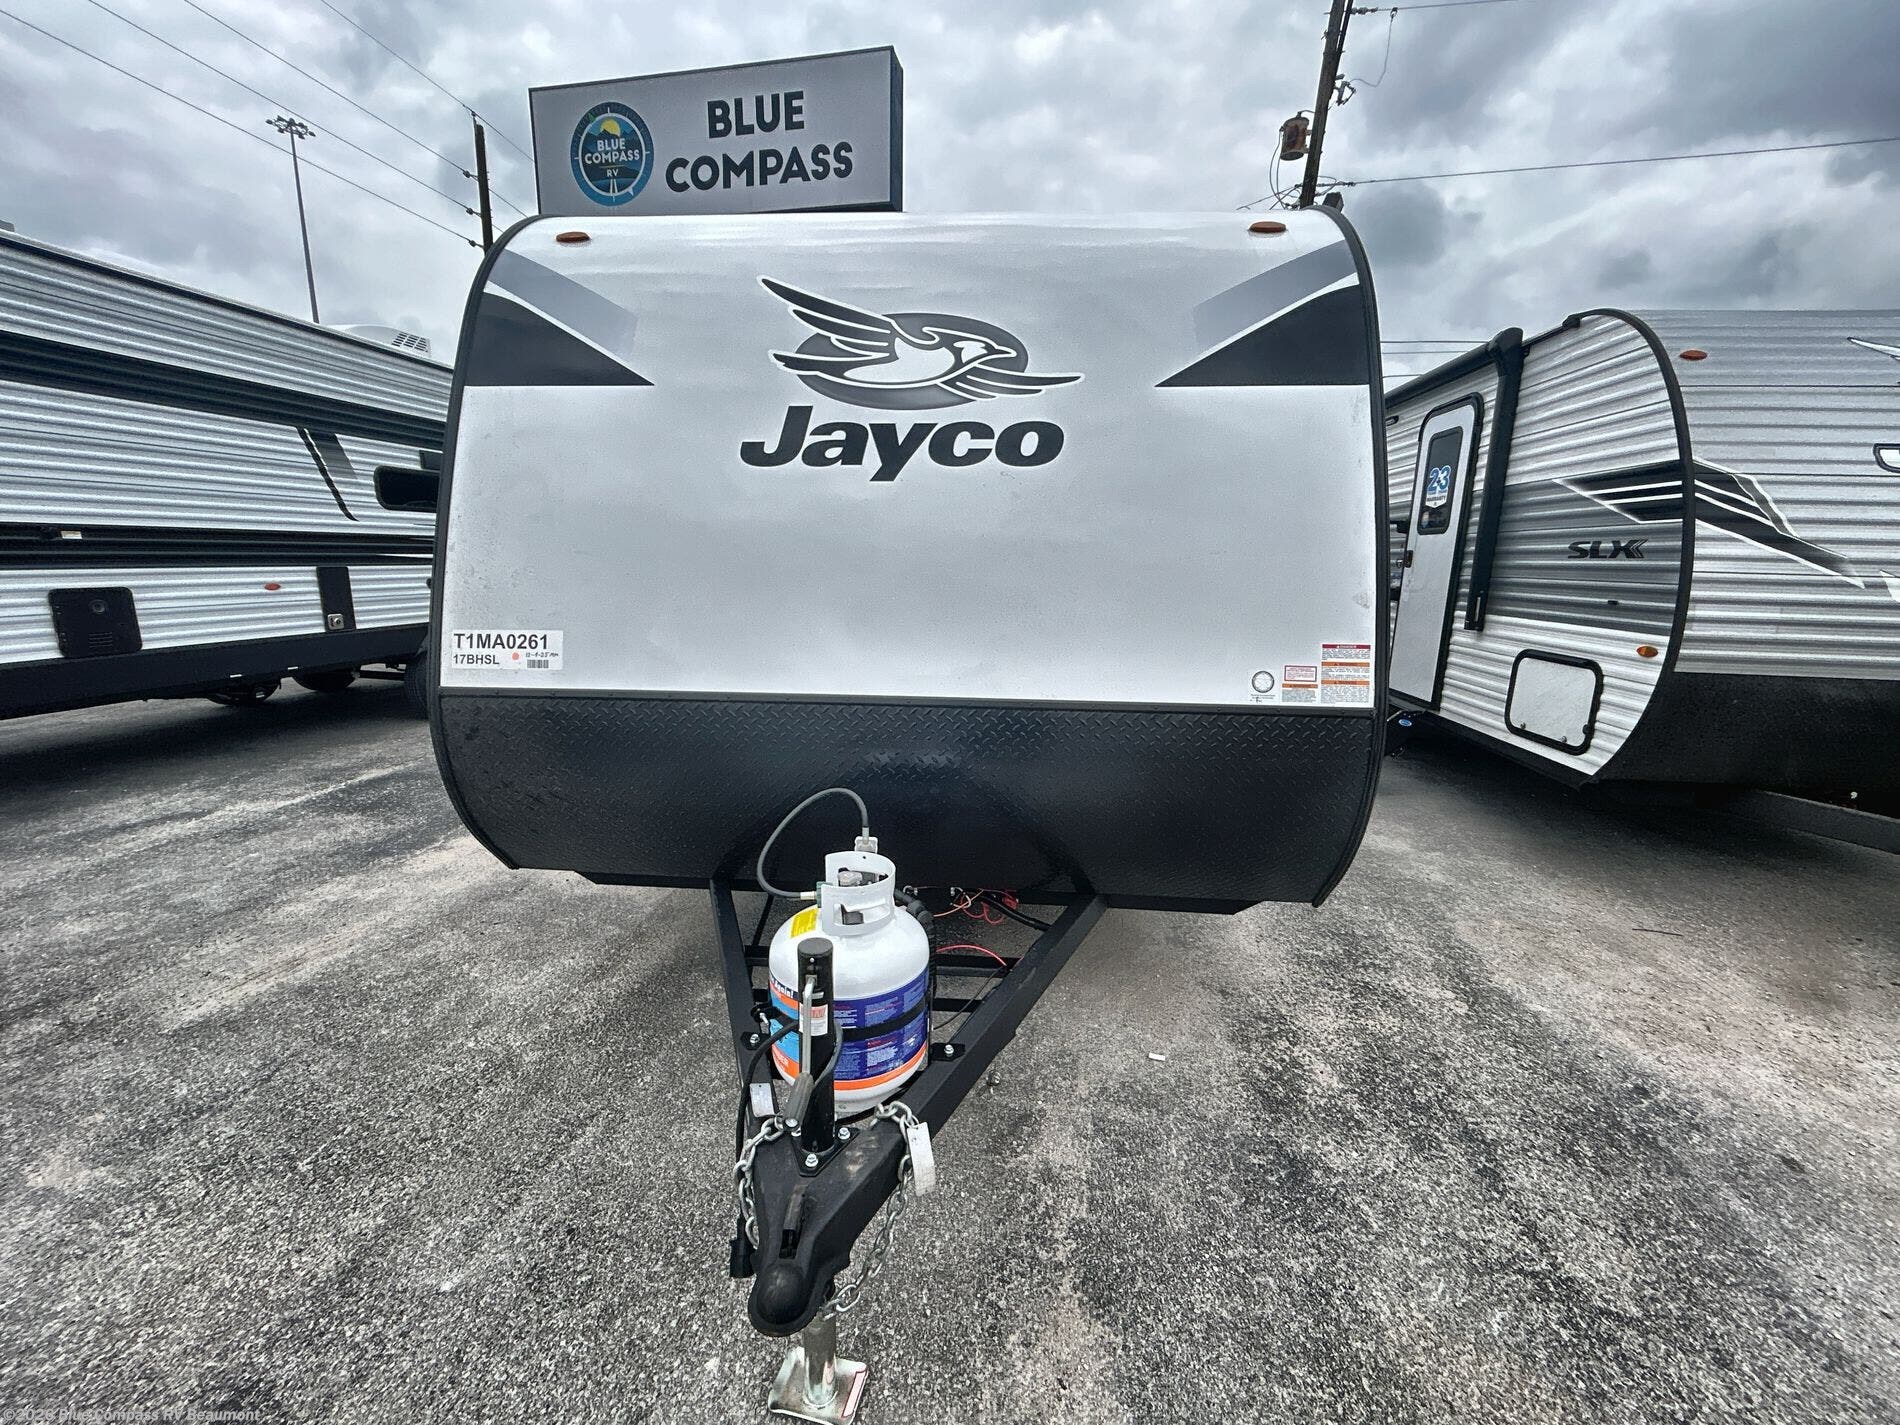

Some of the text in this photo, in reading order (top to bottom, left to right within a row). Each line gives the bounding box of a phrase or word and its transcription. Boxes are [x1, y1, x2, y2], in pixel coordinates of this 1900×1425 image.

[707, 90, 805, 139] BLUE
[597, 138, 626, 152] BLUE
[584, 149, 640, 165] COMPASS
[606, 169, 619, 177] RV
[665, 141, 853, 193] COMPASS
[740, 405, 1065, 482] Jayco
[453, 633, 548, 650] T1MA0261
[453, 654, 500, 665] 17BHSL
